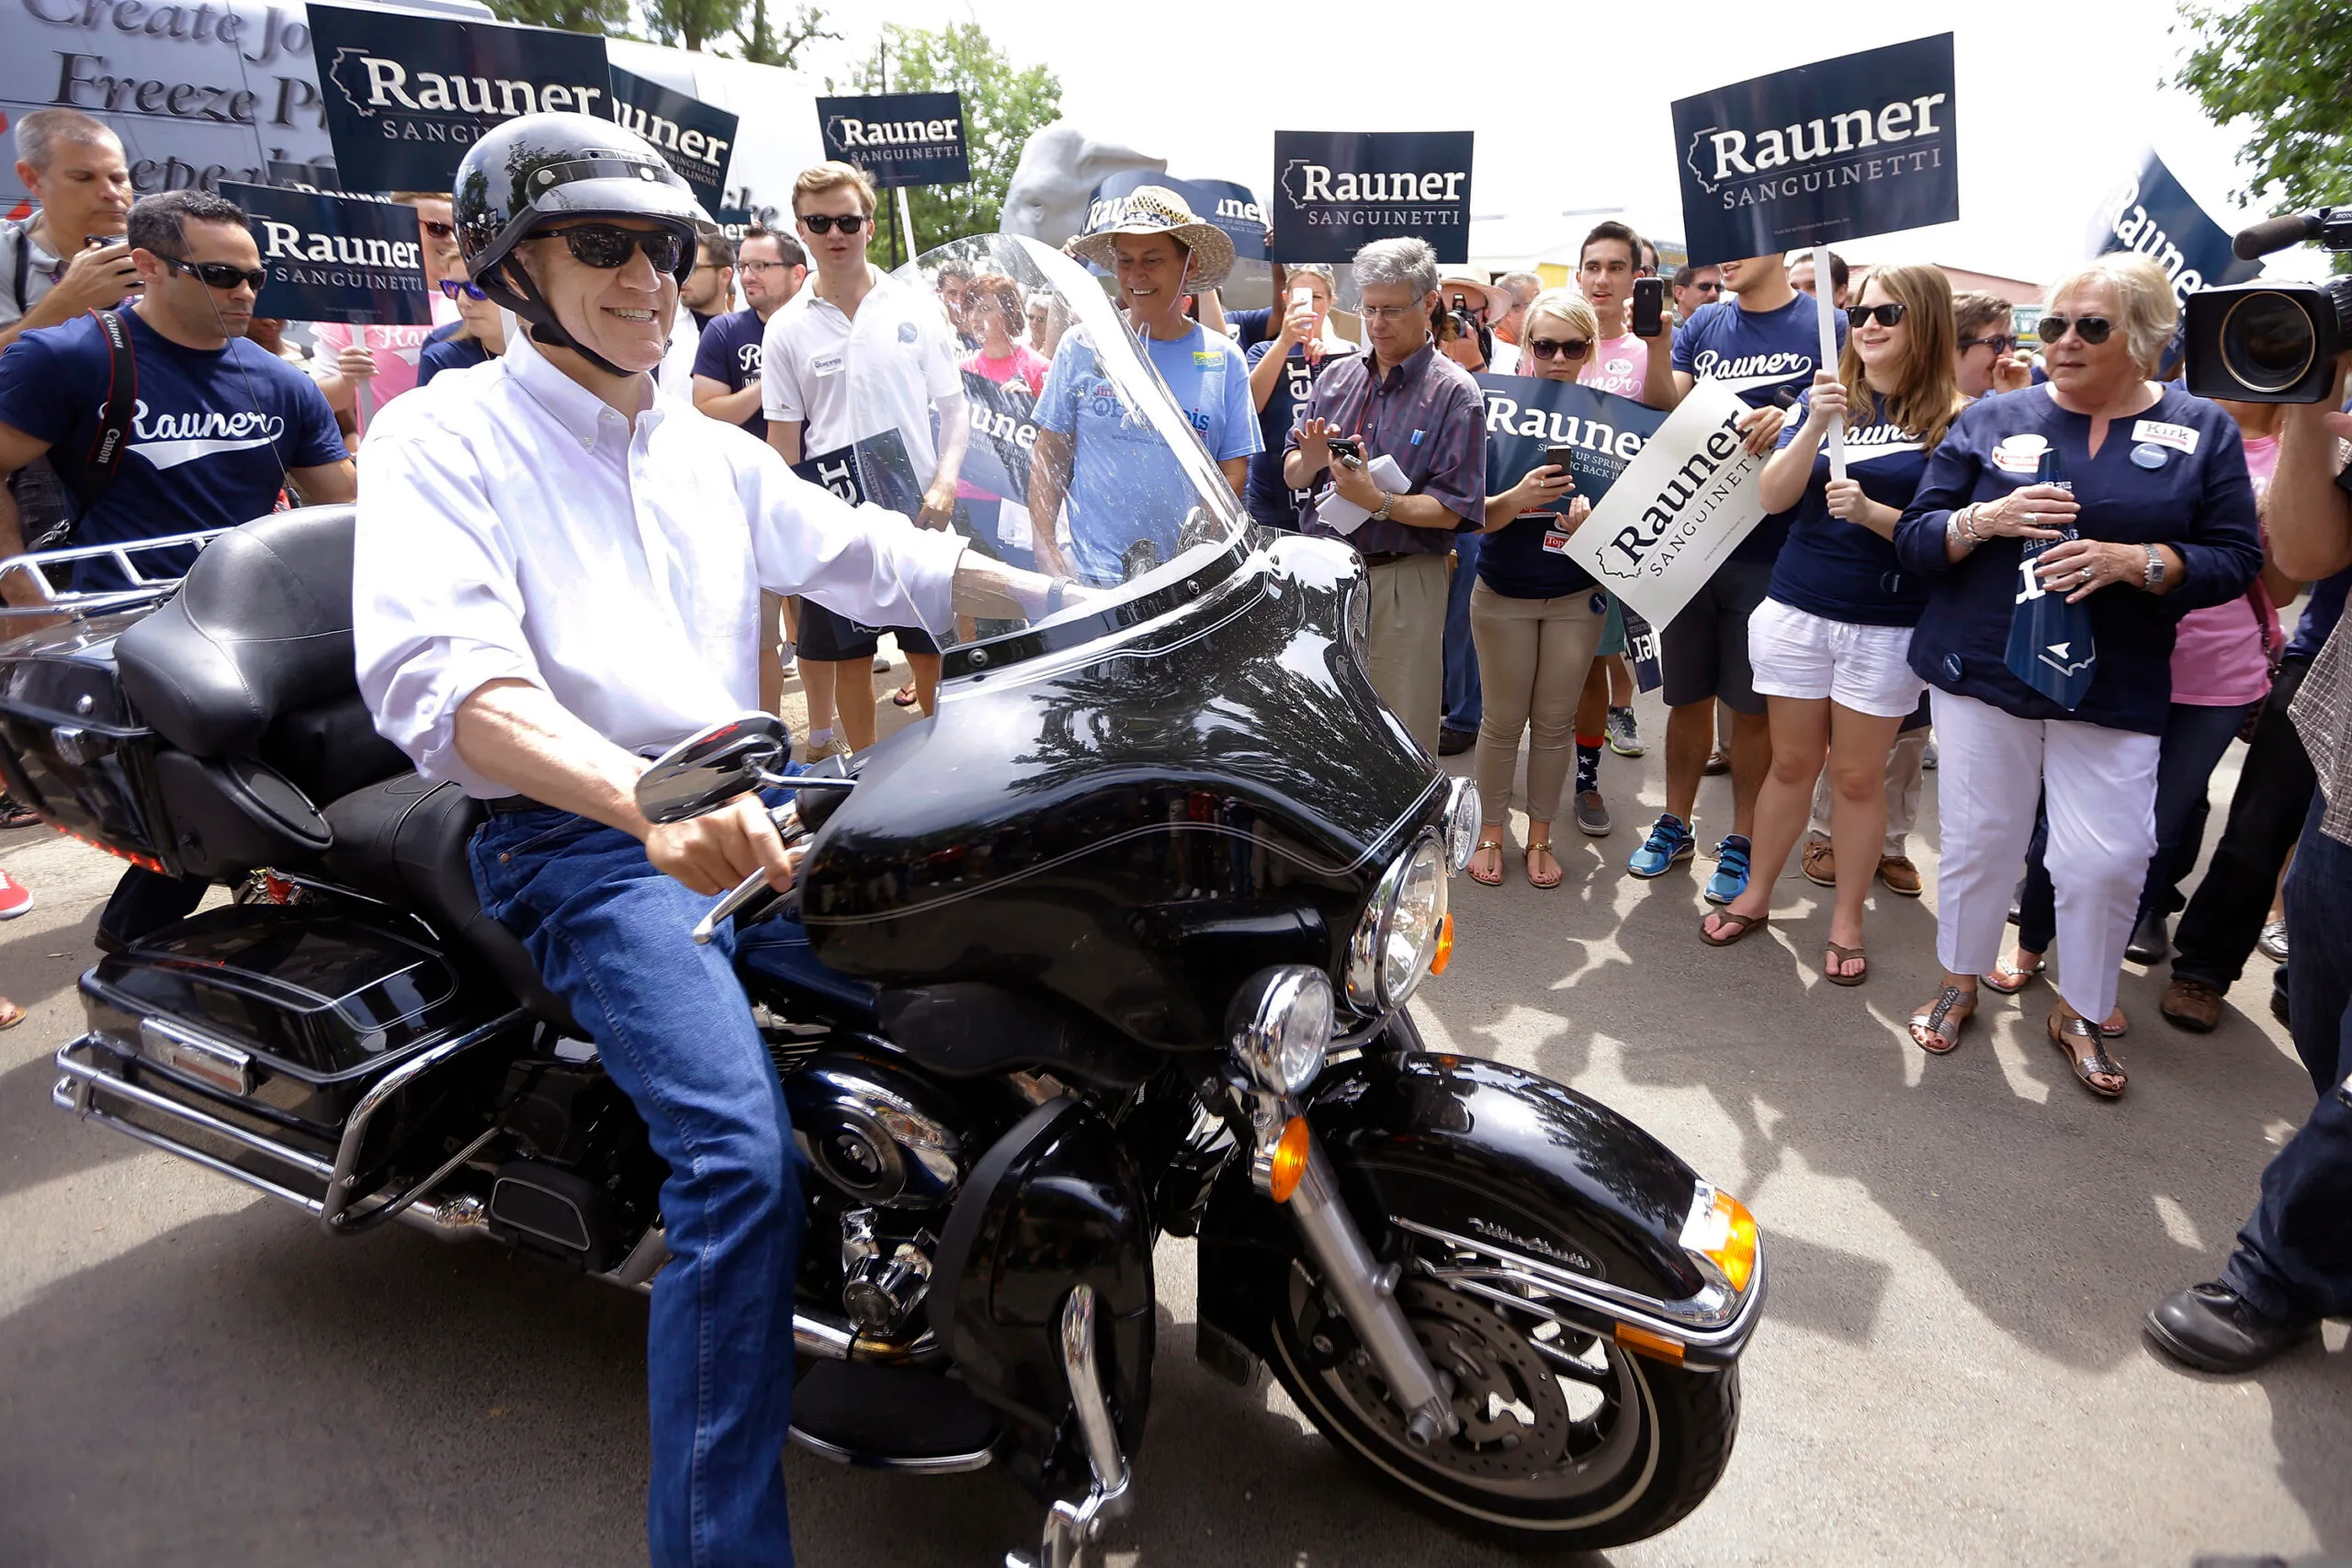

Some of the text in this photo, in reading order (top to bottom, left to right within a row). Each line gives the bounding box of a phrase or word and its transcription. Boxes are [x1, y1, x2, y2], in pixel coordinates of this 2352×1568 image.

[48, 50, 328, 130] Freeze P
[359, 56, 602, 117] Rauner
[840, 118, 958, 147] Rauner
[1710, 92, 1947, 181] Rauner
[851, 145, 960, 162] SANGUINETTI
[1302, 164, 1465, 202] Rauner
[1723, 147, 1942, 209] SANGUINETTI
[1307, 210, 1460, 226] SANGUINETTI
[261, 220, 420, 270] Rauner
[2112, 173, 2213, 315] Raune
[275, 265, 424, 292] SANGUINETTI
[102, 313, 125, 349] Canon
[1694, 350, 1813, 381] Rauner
[99, 399, 285, 439] Rauner
[970, 403, 1040, 450] une
[2146, 423, 2189, 440] Kirk
[97, 428, 120, 465] Canon
[1610, 409, 1754, 567] Rauner
[1650, 445, 1774, 577] SANGUINETT
